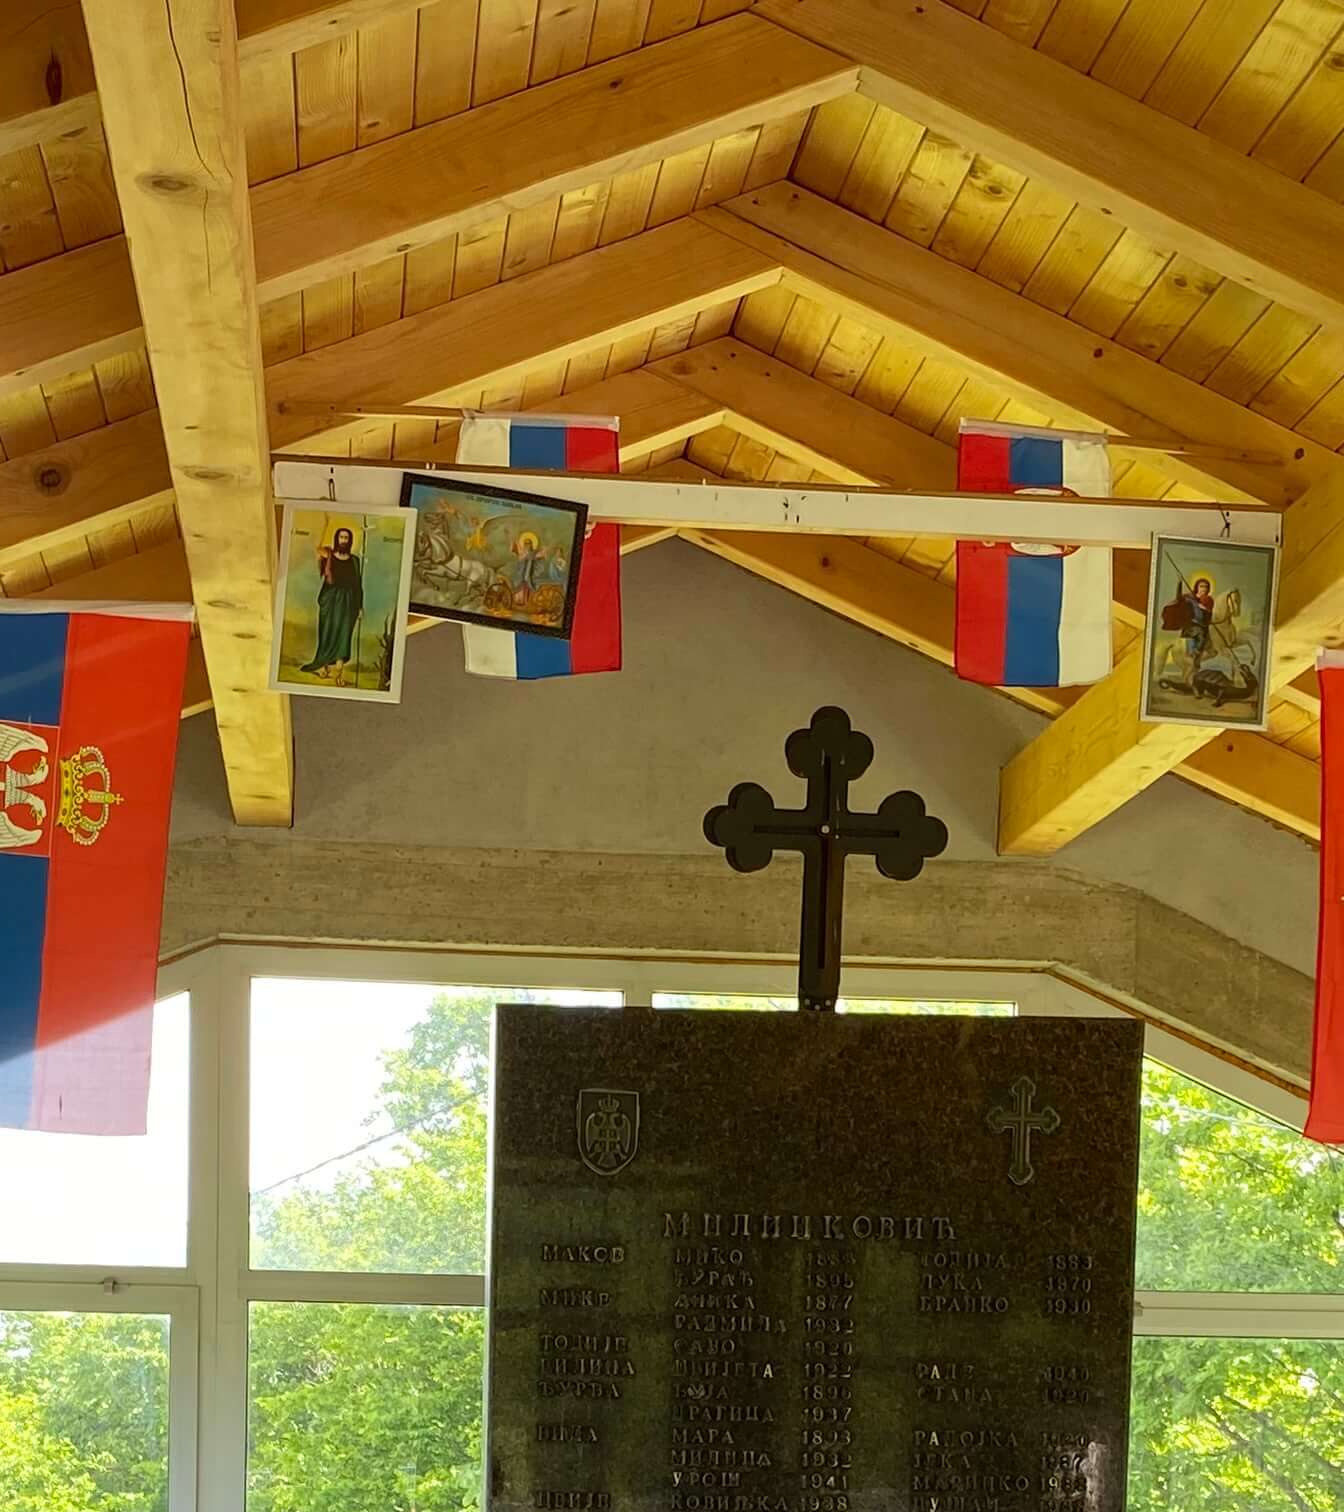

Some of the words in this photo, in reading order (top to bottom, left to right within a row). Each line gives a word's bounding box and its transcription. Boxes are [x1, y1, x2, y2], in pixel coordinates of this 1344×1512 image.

[671, 1427, 735, 1445] МАРА
[671, 1470, 741, 1489] УРОШ
[800, 1473, 850, 1490] 1941
[670, 1494, 789, 1512] КОВИЉКА
